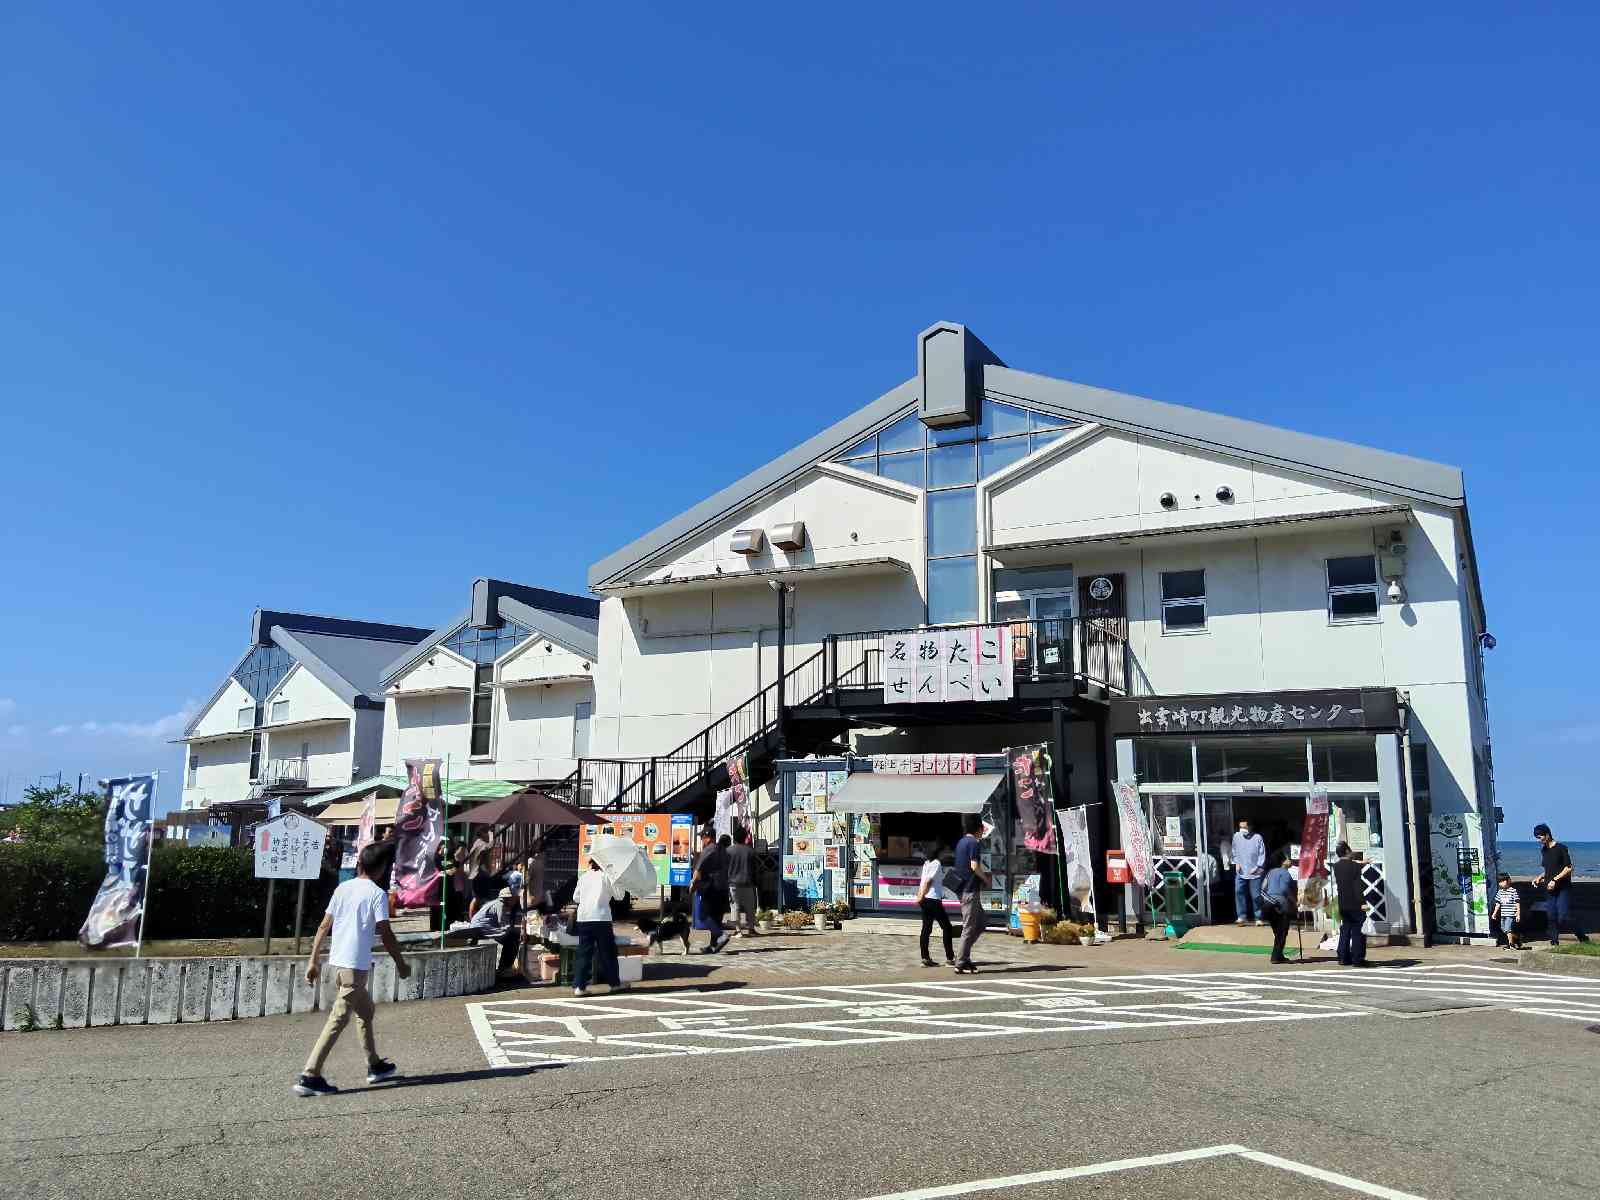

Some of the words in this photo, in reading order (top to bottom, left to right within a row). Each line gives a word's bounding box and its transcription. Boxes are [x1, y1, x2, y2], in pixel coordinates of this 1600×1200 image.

[890, 639, 997, 664] 名物たこ
[889, 674, 1002, 694] せんべい
